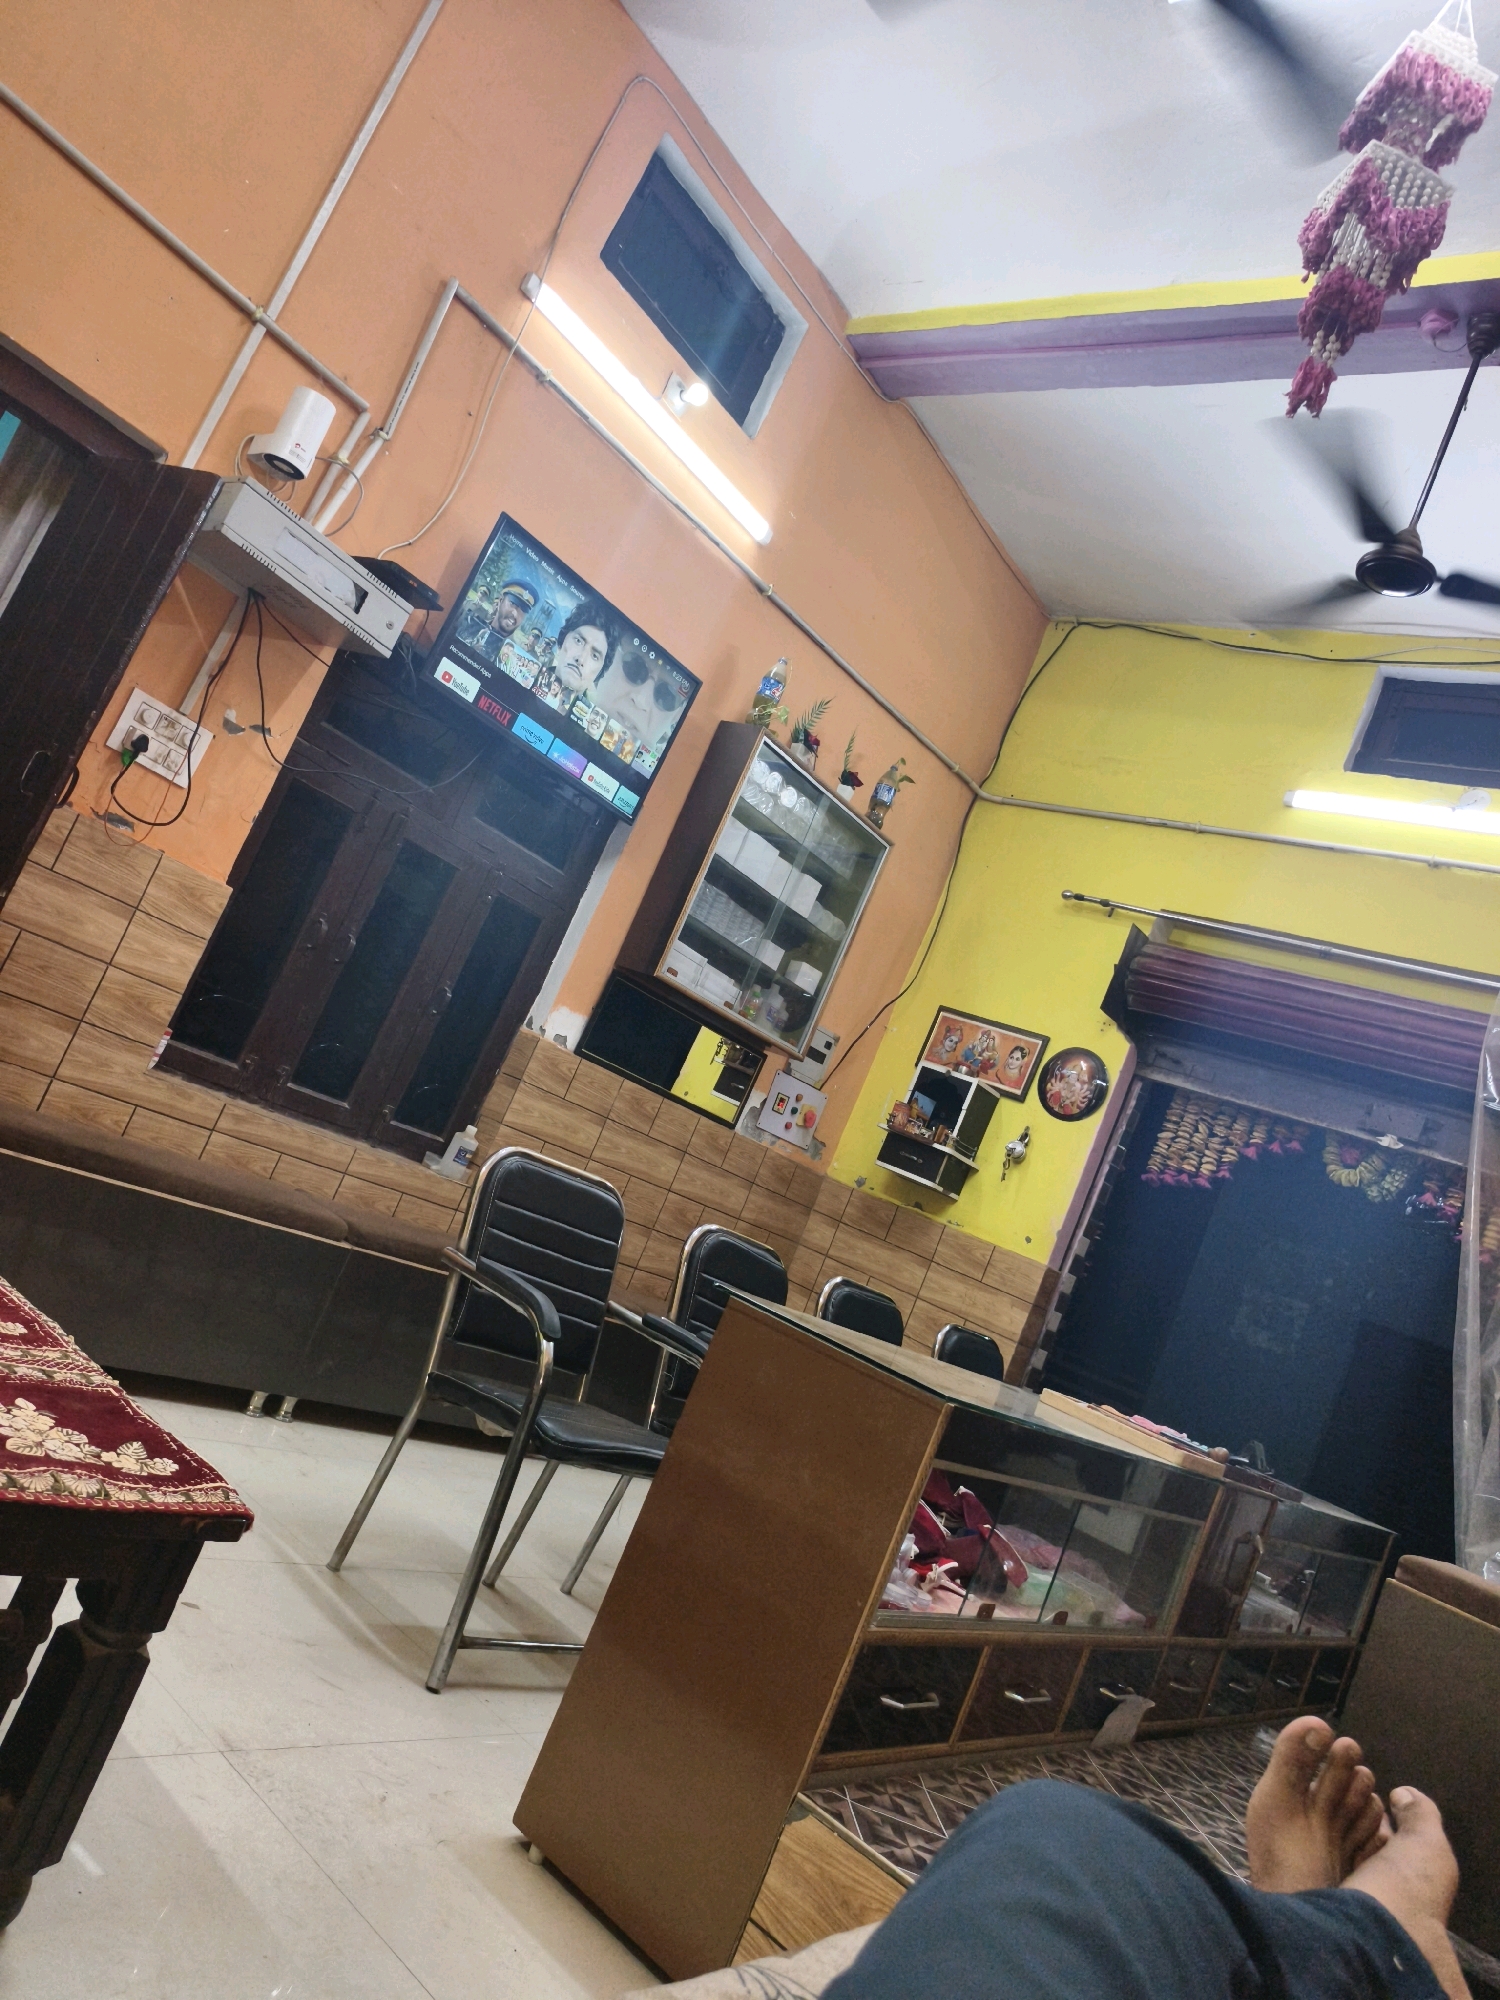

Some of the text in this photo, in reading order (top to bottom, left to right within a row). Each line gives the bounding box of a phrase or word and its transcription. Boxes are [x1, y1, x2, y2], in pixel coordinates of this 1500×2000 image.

[509, 533, 524, 549] Home
[526, 547, 539, 562] Video
[540, 561, 555, 575] Music
[556, 574, 569, 587] Apps
[569, 585, 585, 601] Source
[449, 644, 492, 679] Recommended Apps
[451, 677, 470, 696] YouTube
[477, 694, 512, 727] NETFLIX
